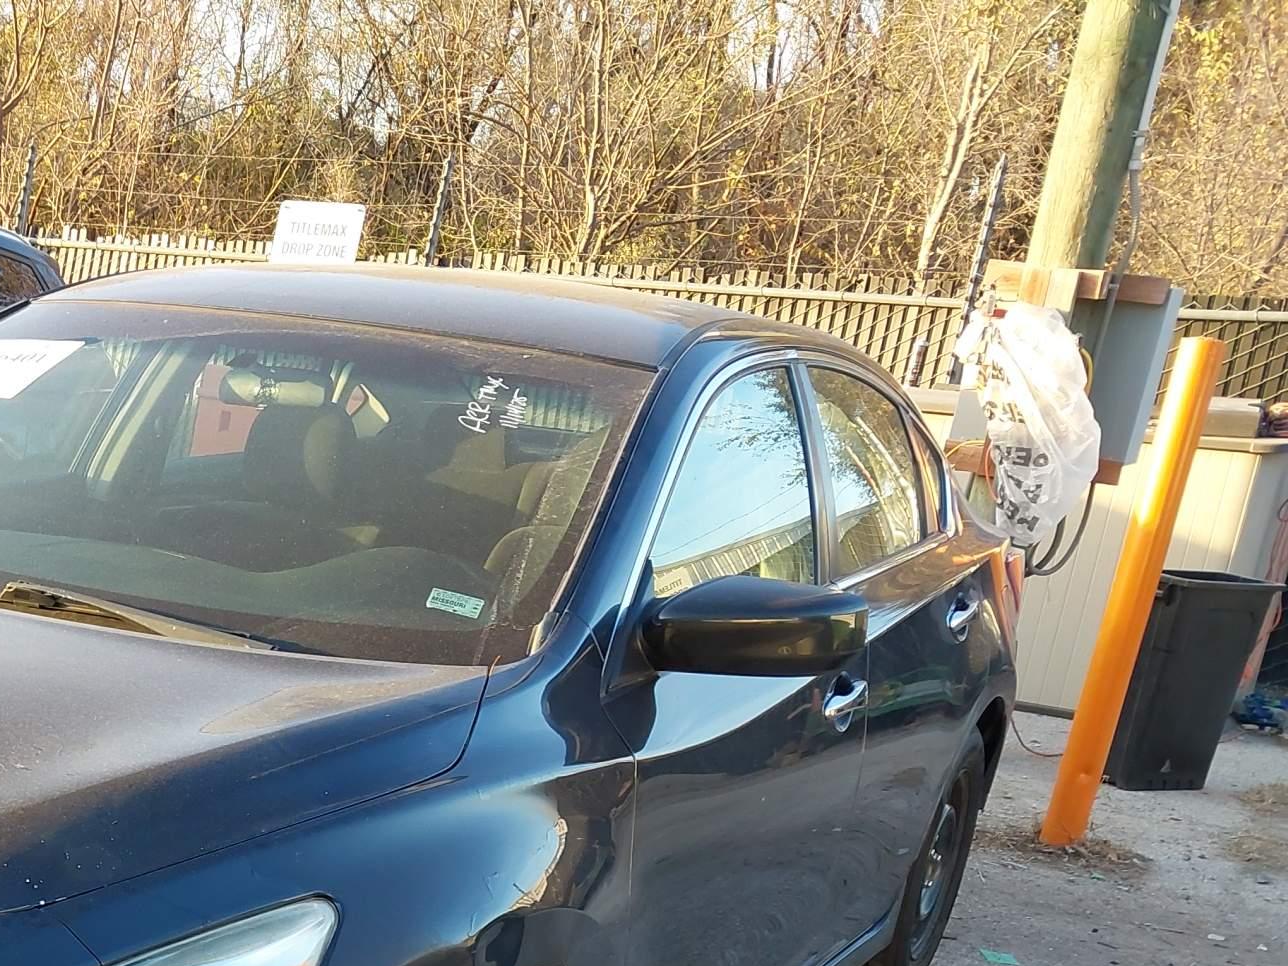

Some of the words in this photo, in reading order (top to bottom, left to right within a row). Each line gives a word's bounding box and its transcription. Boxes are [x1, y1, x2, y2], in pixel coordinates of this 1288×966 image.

[290, 221, 348, 237] TITLEMAX
[281, 241, 314, 256] DROP
[315, 243, 347, 258] ZONE
